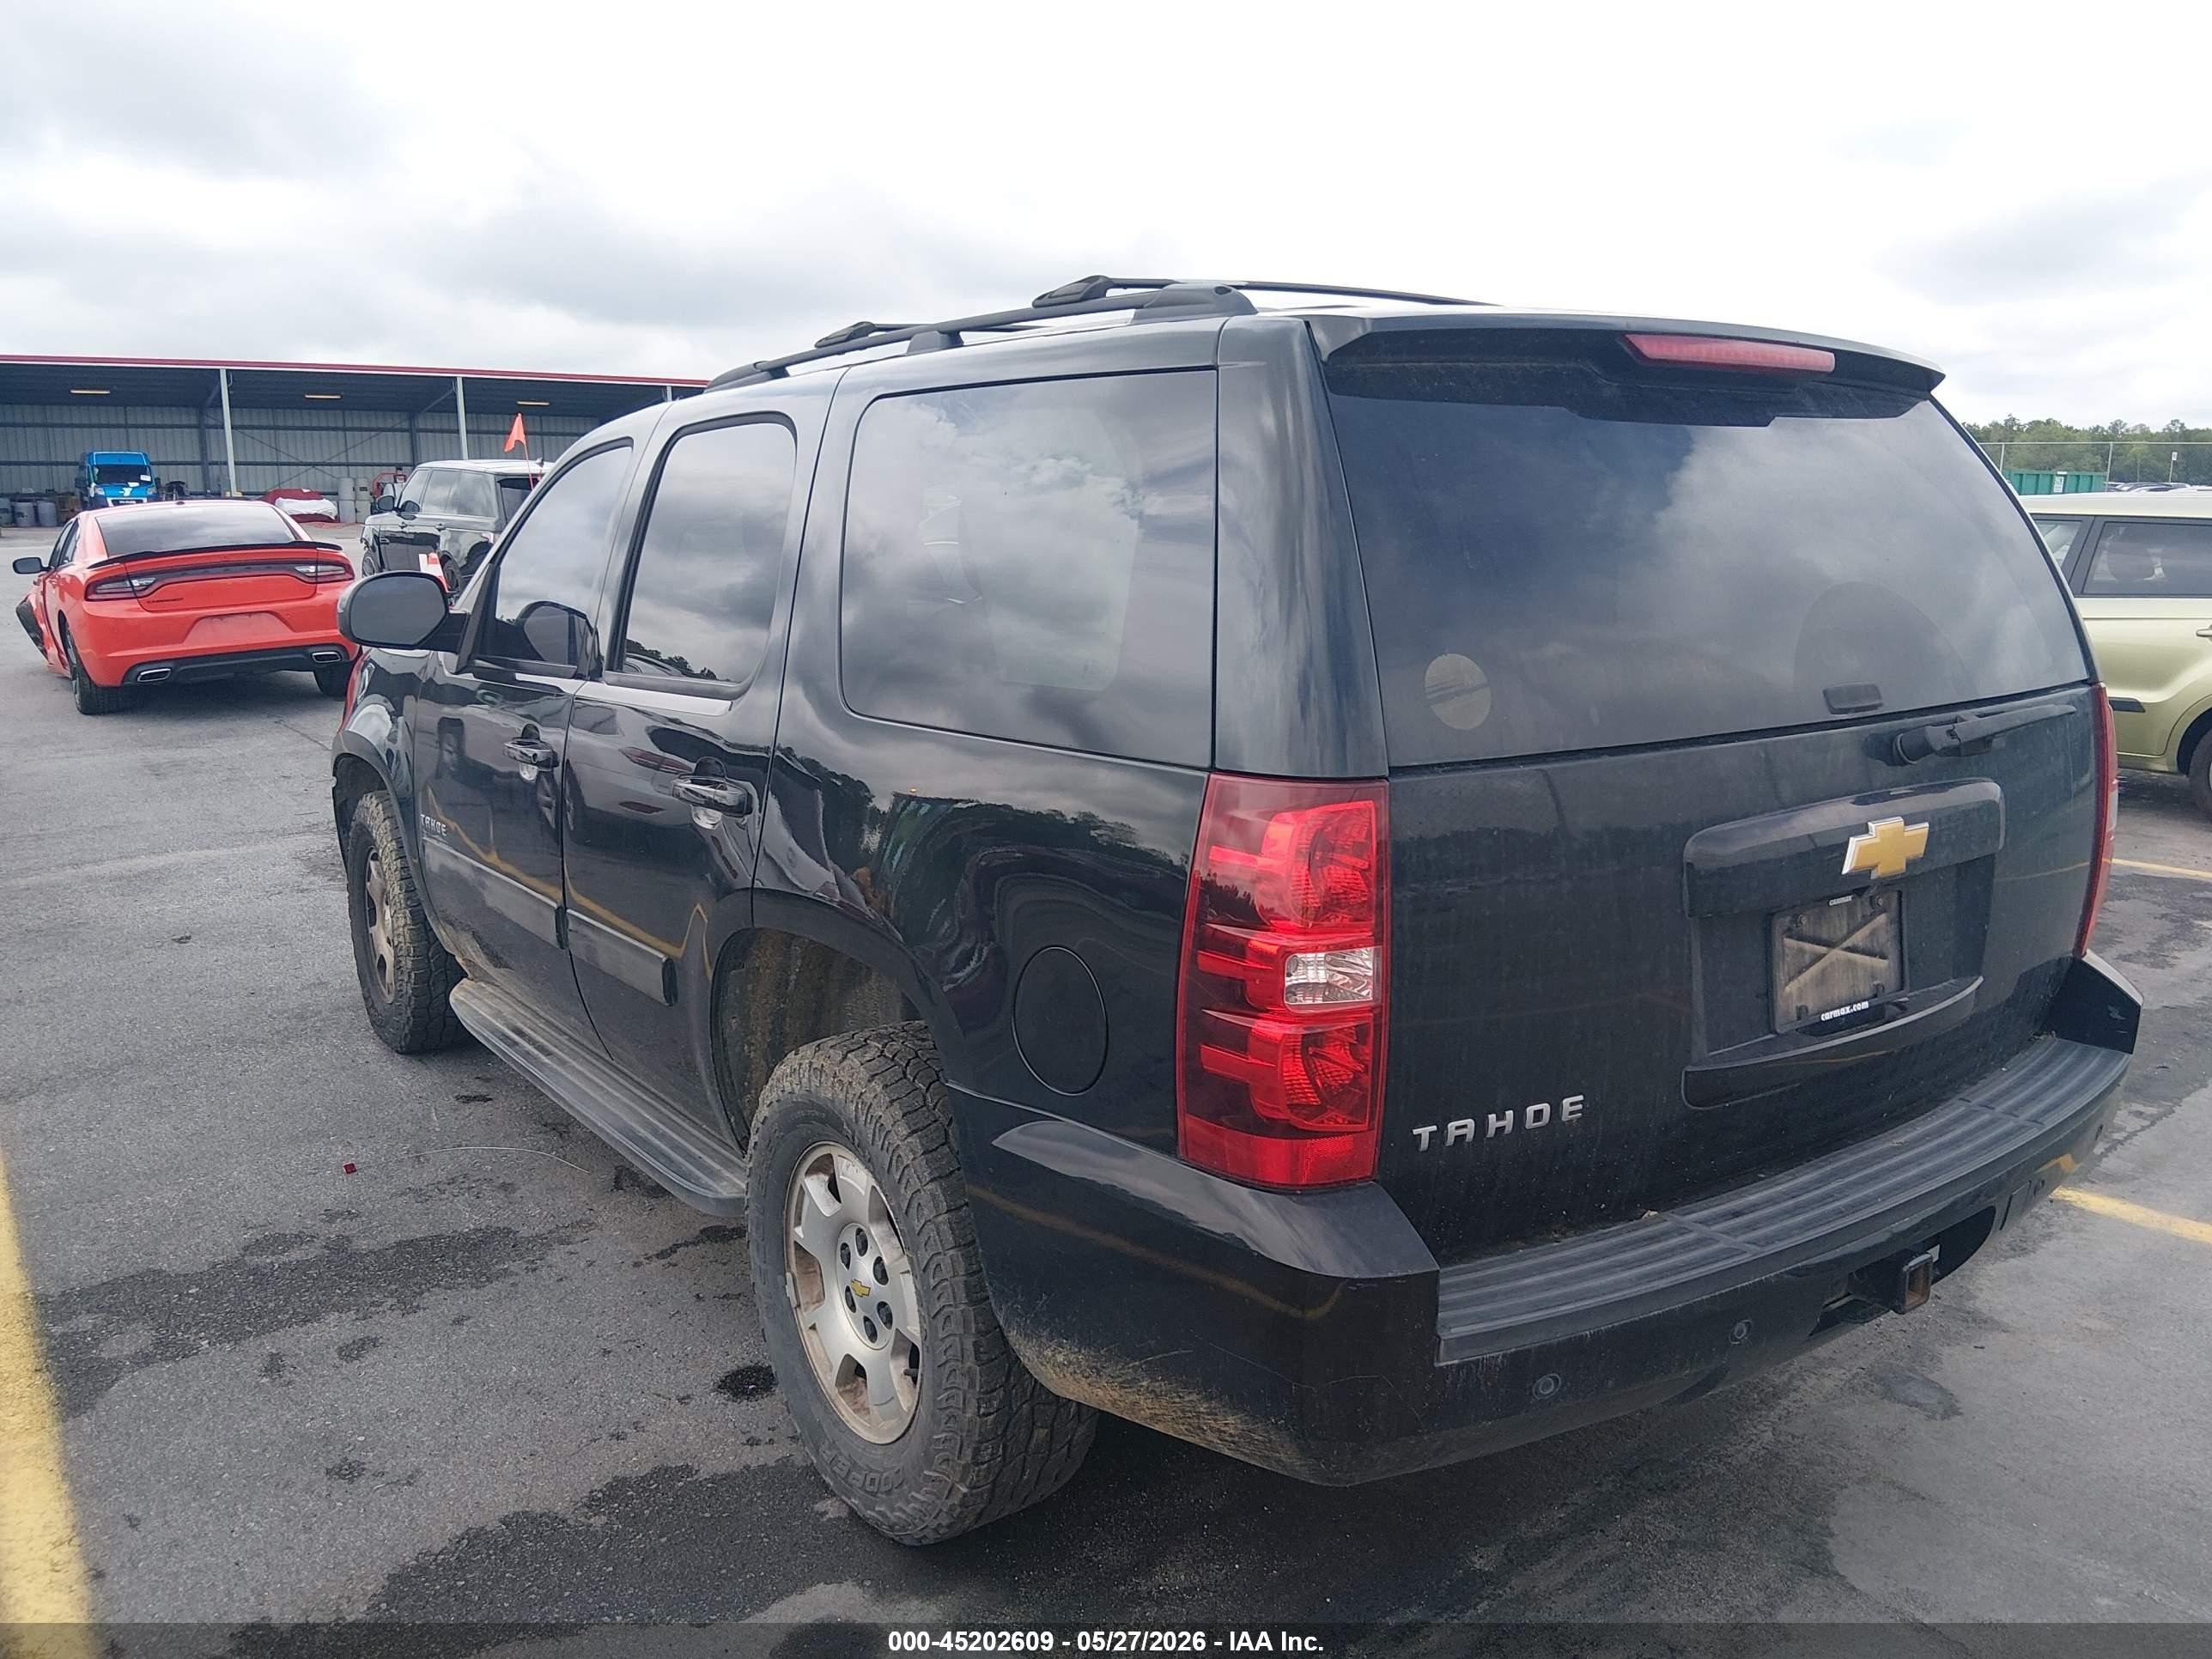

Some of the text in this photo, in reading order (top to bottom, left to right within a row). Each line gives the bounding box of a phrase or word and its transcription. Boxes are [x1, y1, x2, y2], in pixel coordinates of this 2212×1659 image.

[421, 813, 447, 836] TAHOE
[1820, 1000, 1869, 1022] carmax.com
[1412, 1095, 1584, 1152] TAHOE
